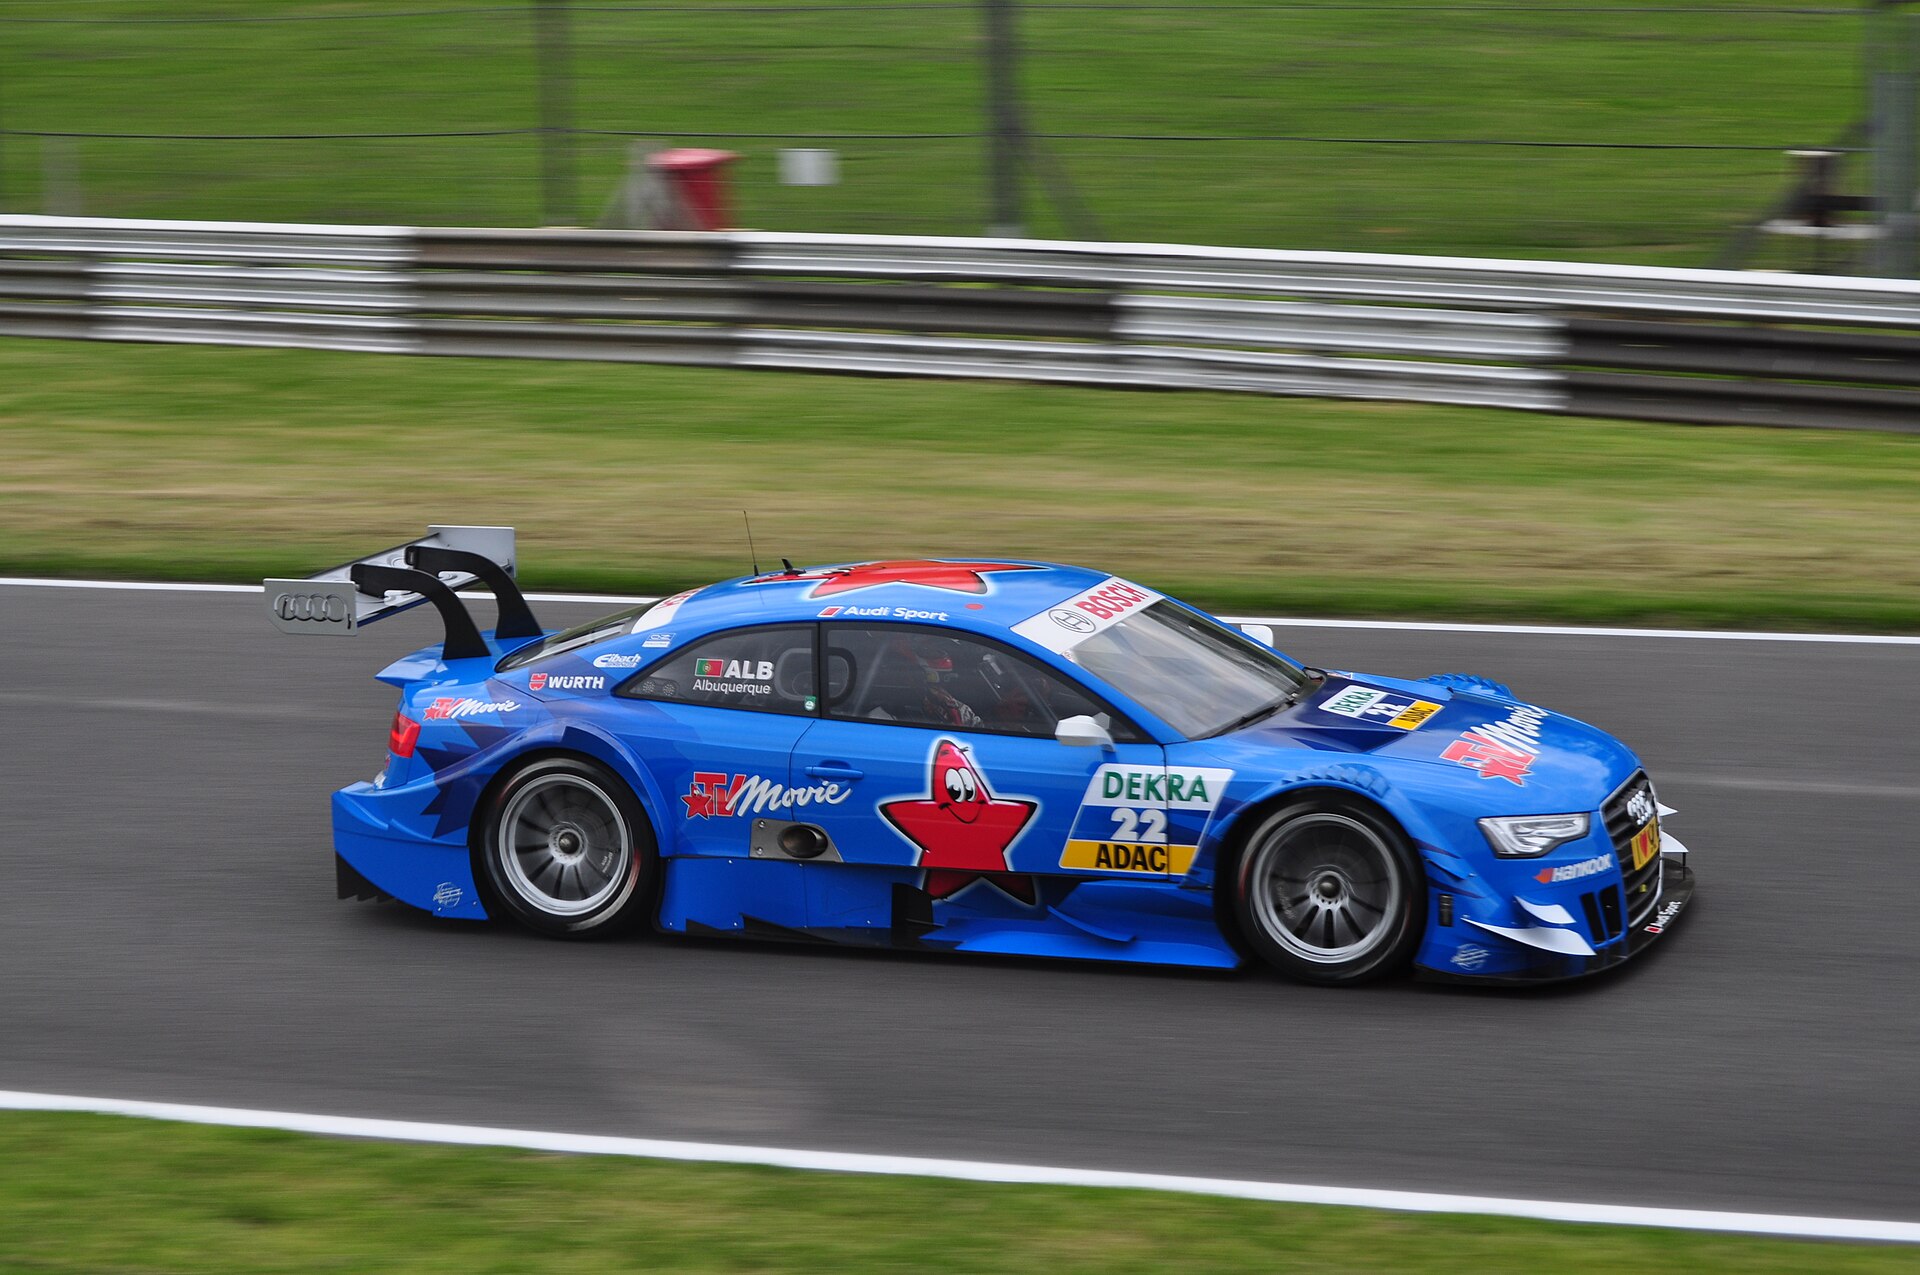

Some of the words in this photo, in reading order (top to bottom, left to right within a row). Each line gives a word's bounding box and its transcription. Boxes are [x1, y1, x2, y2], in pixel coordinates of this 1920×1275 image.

[1073, 581, 1149, 620] BOSCH
[843, 605, 890, 617] Audi
[893, 607, 950, 621] Sport
[593, 653, 641, 668] Eibach
[723, 660, 775, 680] ALB
[693, 679, 771, 695] Albuquerque
[434, 697, 464, 719] TV
[447, 698, 521, 719] Movie
[1328, 690, 1380, 713] DEKRA
[1365, 702, 1408, 718] 22
[693, 771, 748, 817] TV
[725, 774, 852, 817] Movie
[1102, 771, 1209, 803] DEKRA
[1110, 807, 1168, 843] 22
[1095, 843, 1166, 872] ADAC
